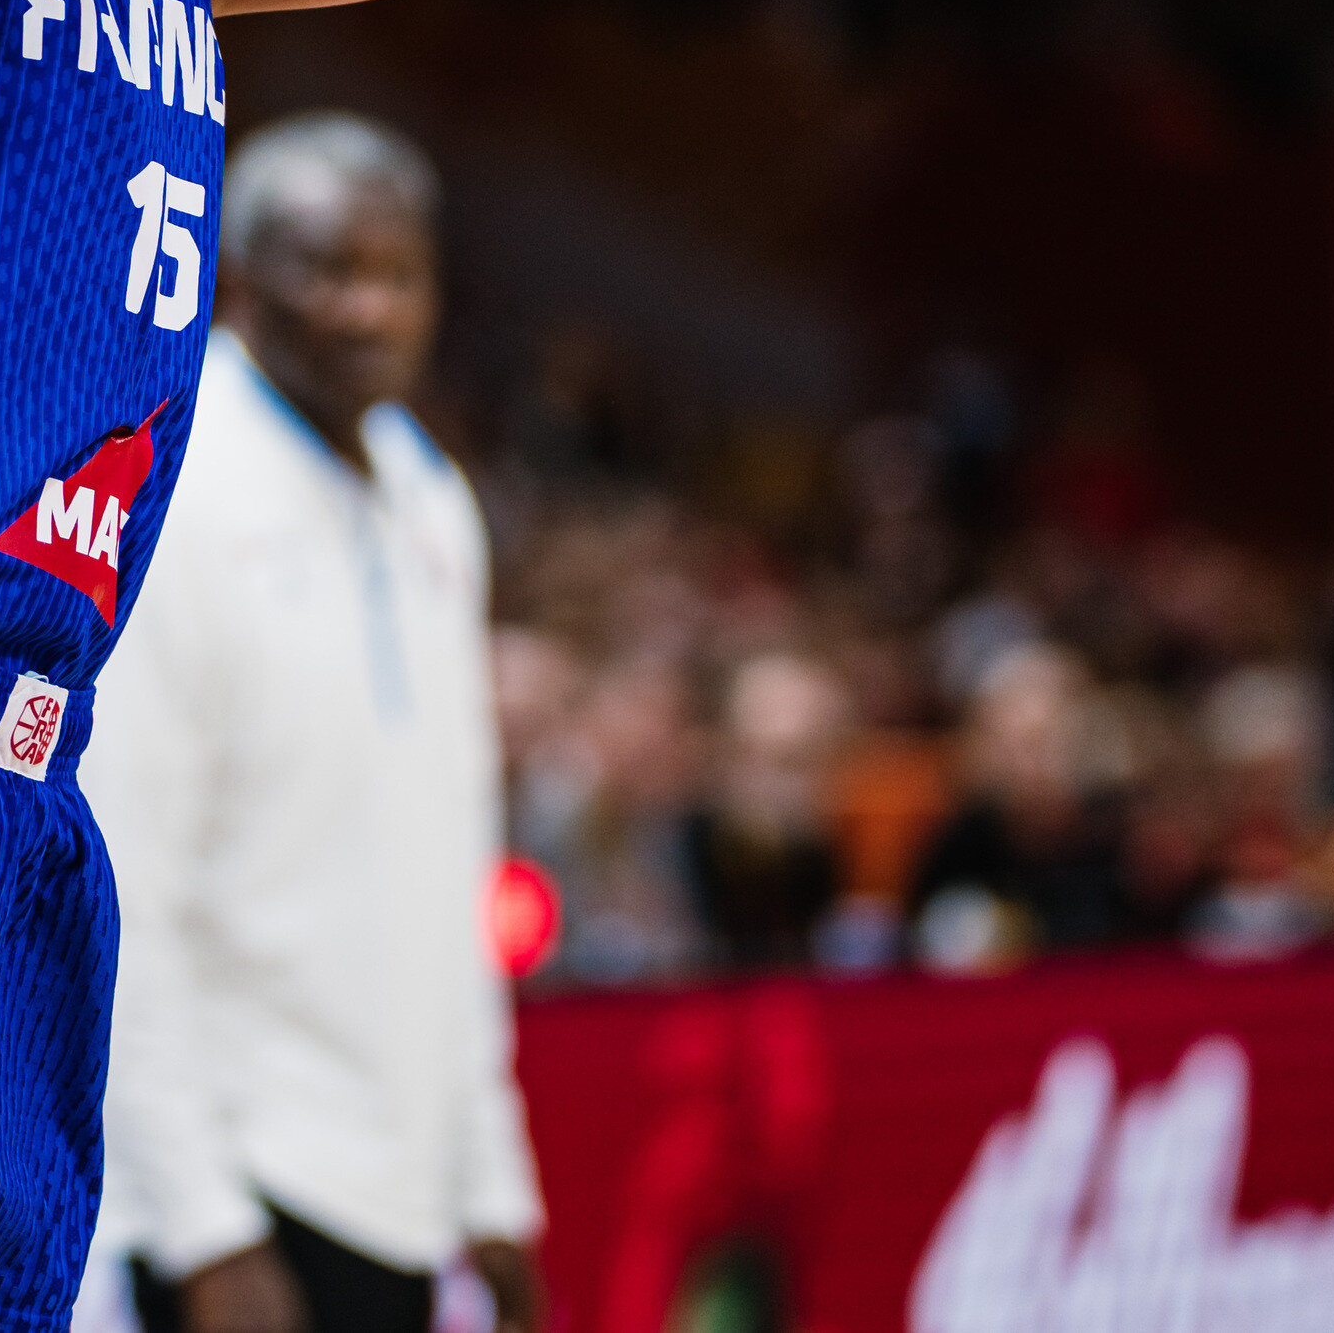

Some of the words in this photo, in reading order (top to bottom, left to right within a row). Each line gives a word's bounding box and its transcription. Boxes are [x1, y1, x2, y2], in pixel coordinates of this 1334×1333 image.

[125, 161, 205, 332] 15
[36, 477, 130, 572] MA
[20, 697, 54, 765] FRA
